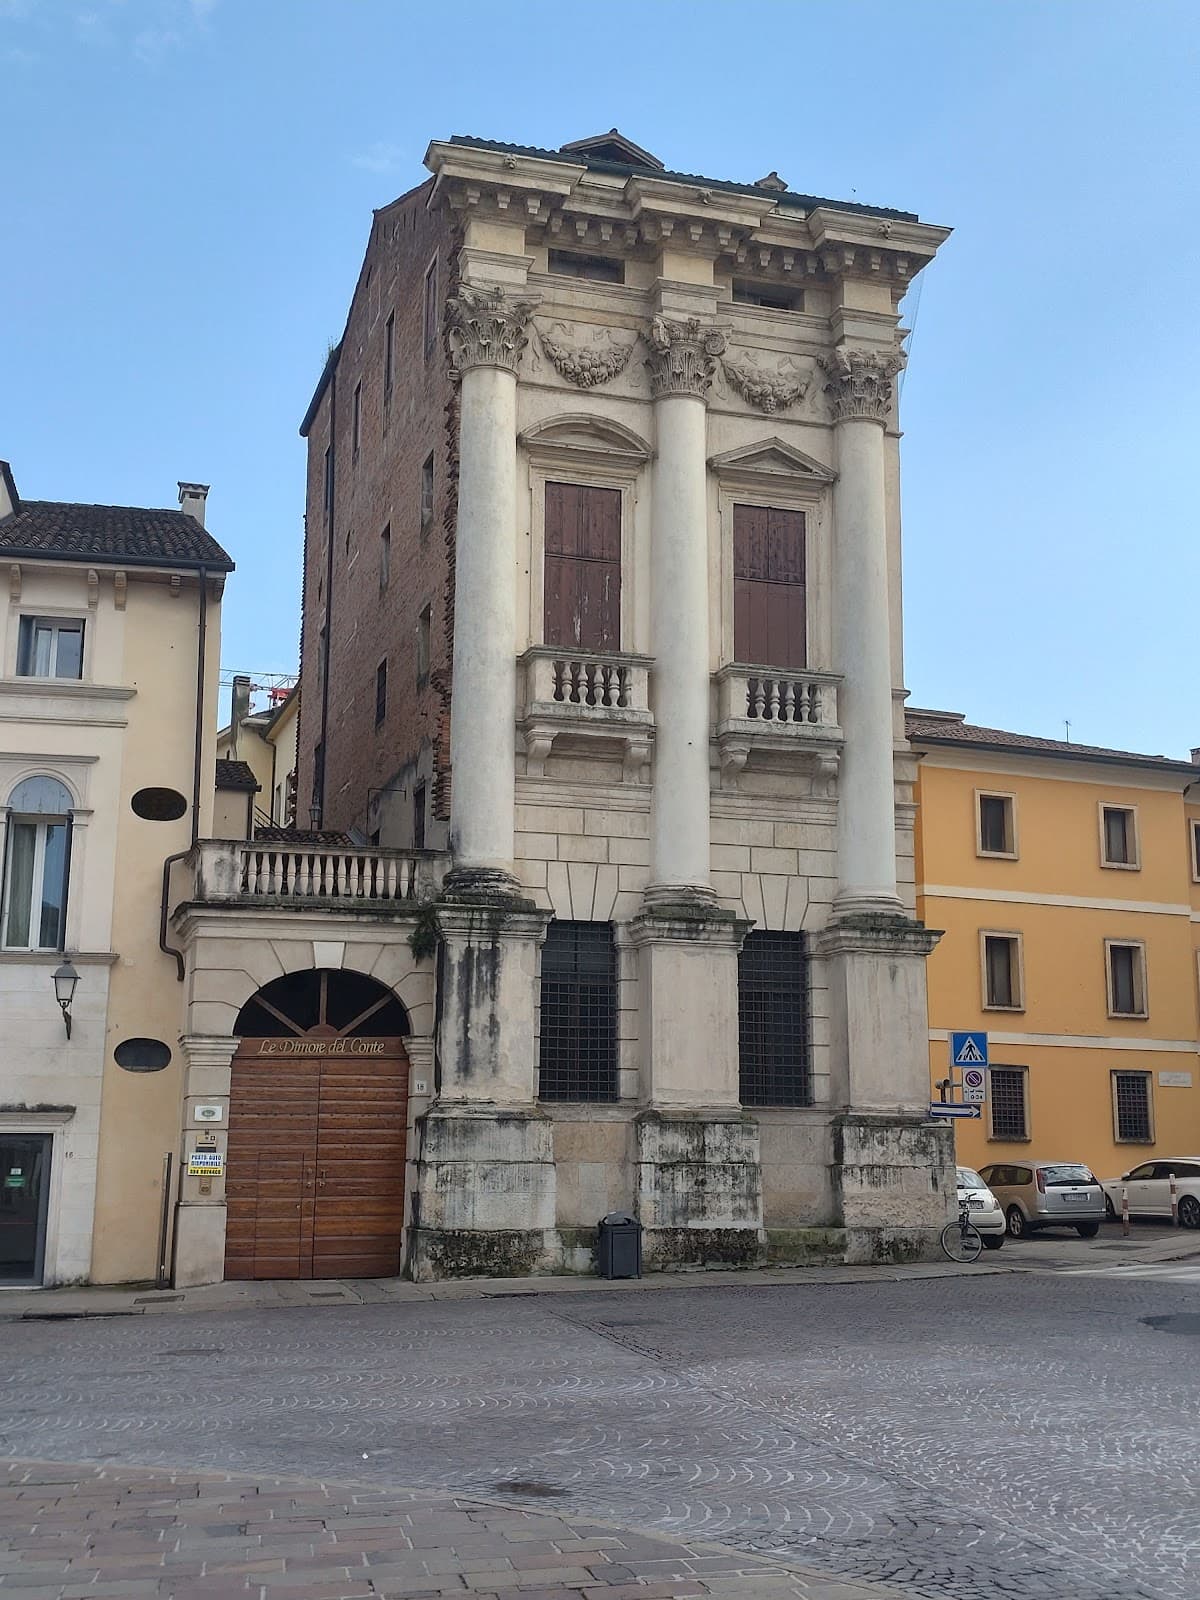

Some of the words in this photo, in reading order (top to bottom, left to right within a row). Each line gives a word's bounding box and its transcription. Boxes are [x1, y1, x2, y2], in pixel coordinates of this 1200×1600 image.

[258, 1039, 277, 1054] Le
[279, 1040, 326, 1054] Dimore
[328, 1037, 349, 1053] del
[350, 1037, 385, 1053] Conte
